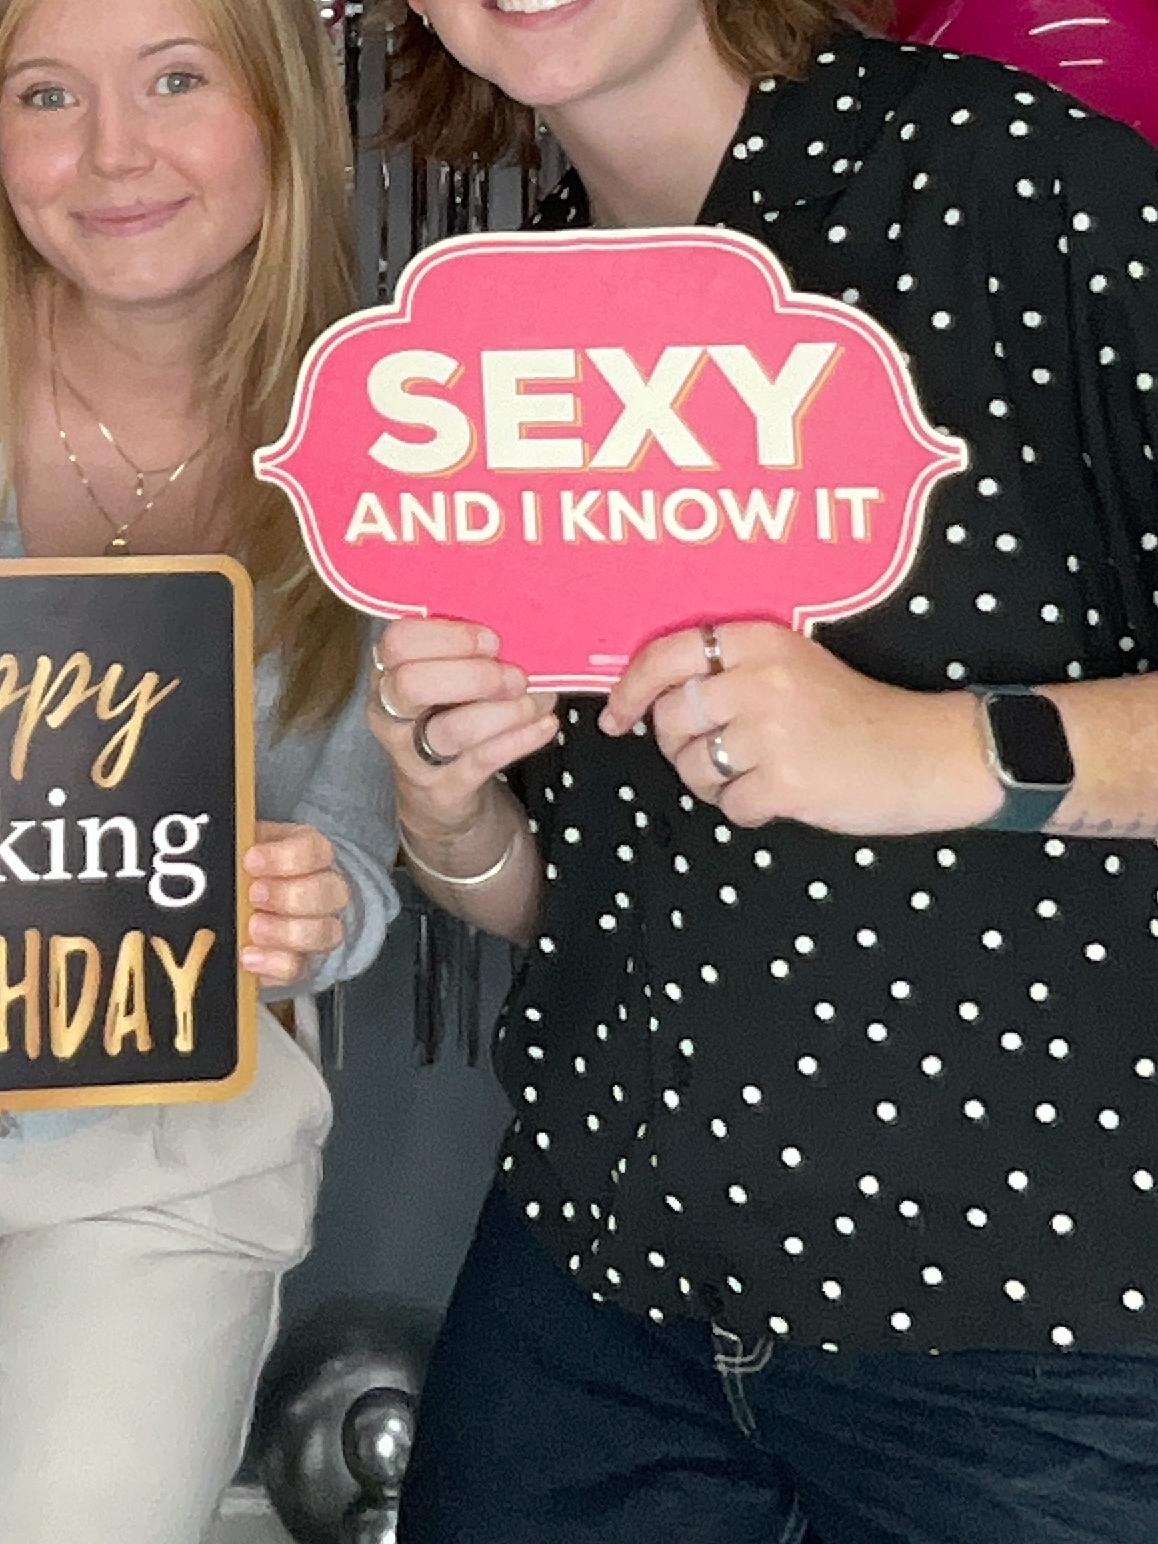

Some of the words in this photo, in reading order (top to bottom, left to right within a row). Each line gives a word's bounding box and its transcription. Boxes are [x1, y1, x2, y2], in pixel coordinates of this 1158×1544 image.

[366, 342, 844, 475] SEXY
[344, 491, 504, 545] AND
[523, 490, 541, 545] I
[560, 487, 800, 544] KNOW
[816, 486, 885, 543] IT
